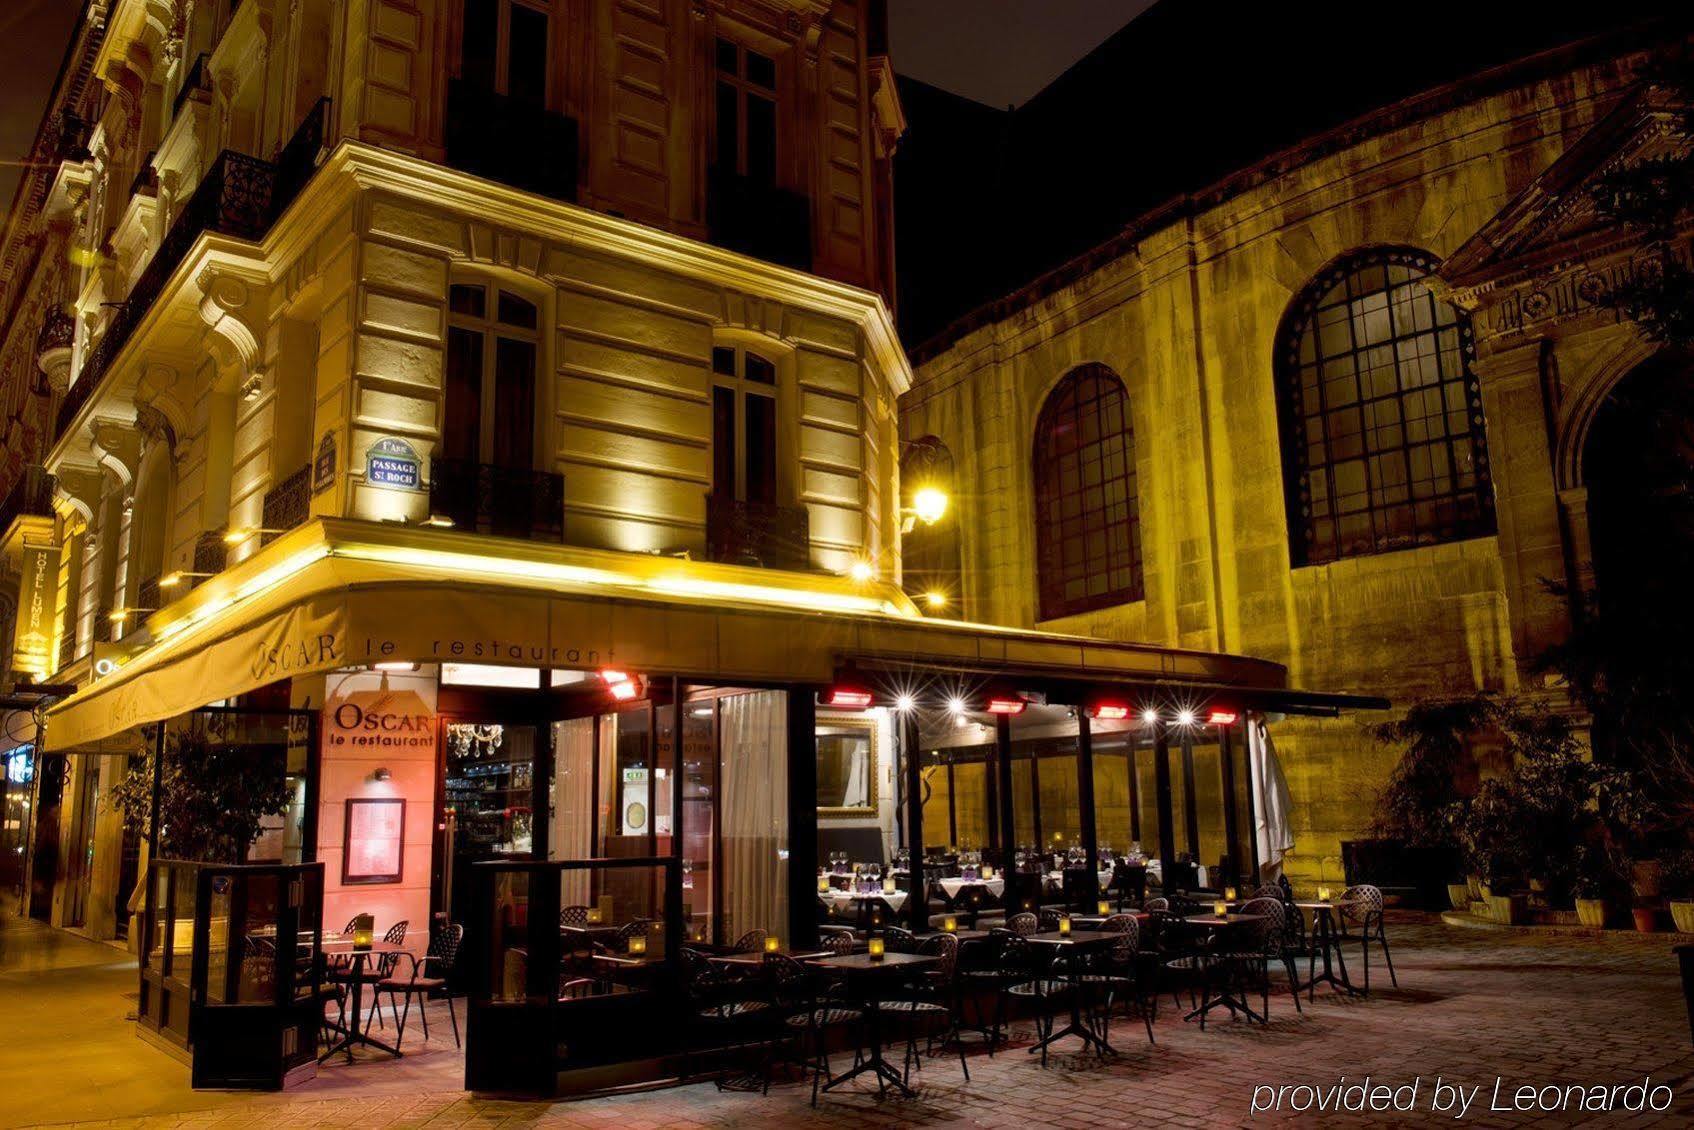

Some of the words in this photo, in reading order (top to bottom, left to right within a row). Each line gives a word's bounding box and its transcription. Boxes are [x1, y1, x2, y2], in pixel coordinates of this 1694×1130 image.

[373, 460, 416, 473] PASSAGE
[387, 472, 413, 483] ROCH
[36, 552, 47, 588] HOTEL
[32, 592, 43, 628] LUMEN
[251, 633, 336, 680] OSCAR
[366, 637, 395, 656] le
[433, 638, 616, 665] restaurant
[334, 703, 430, 732] OSCAR
[330, 734, 346, 746] le
[351, 734, 434, 748] restaurant
